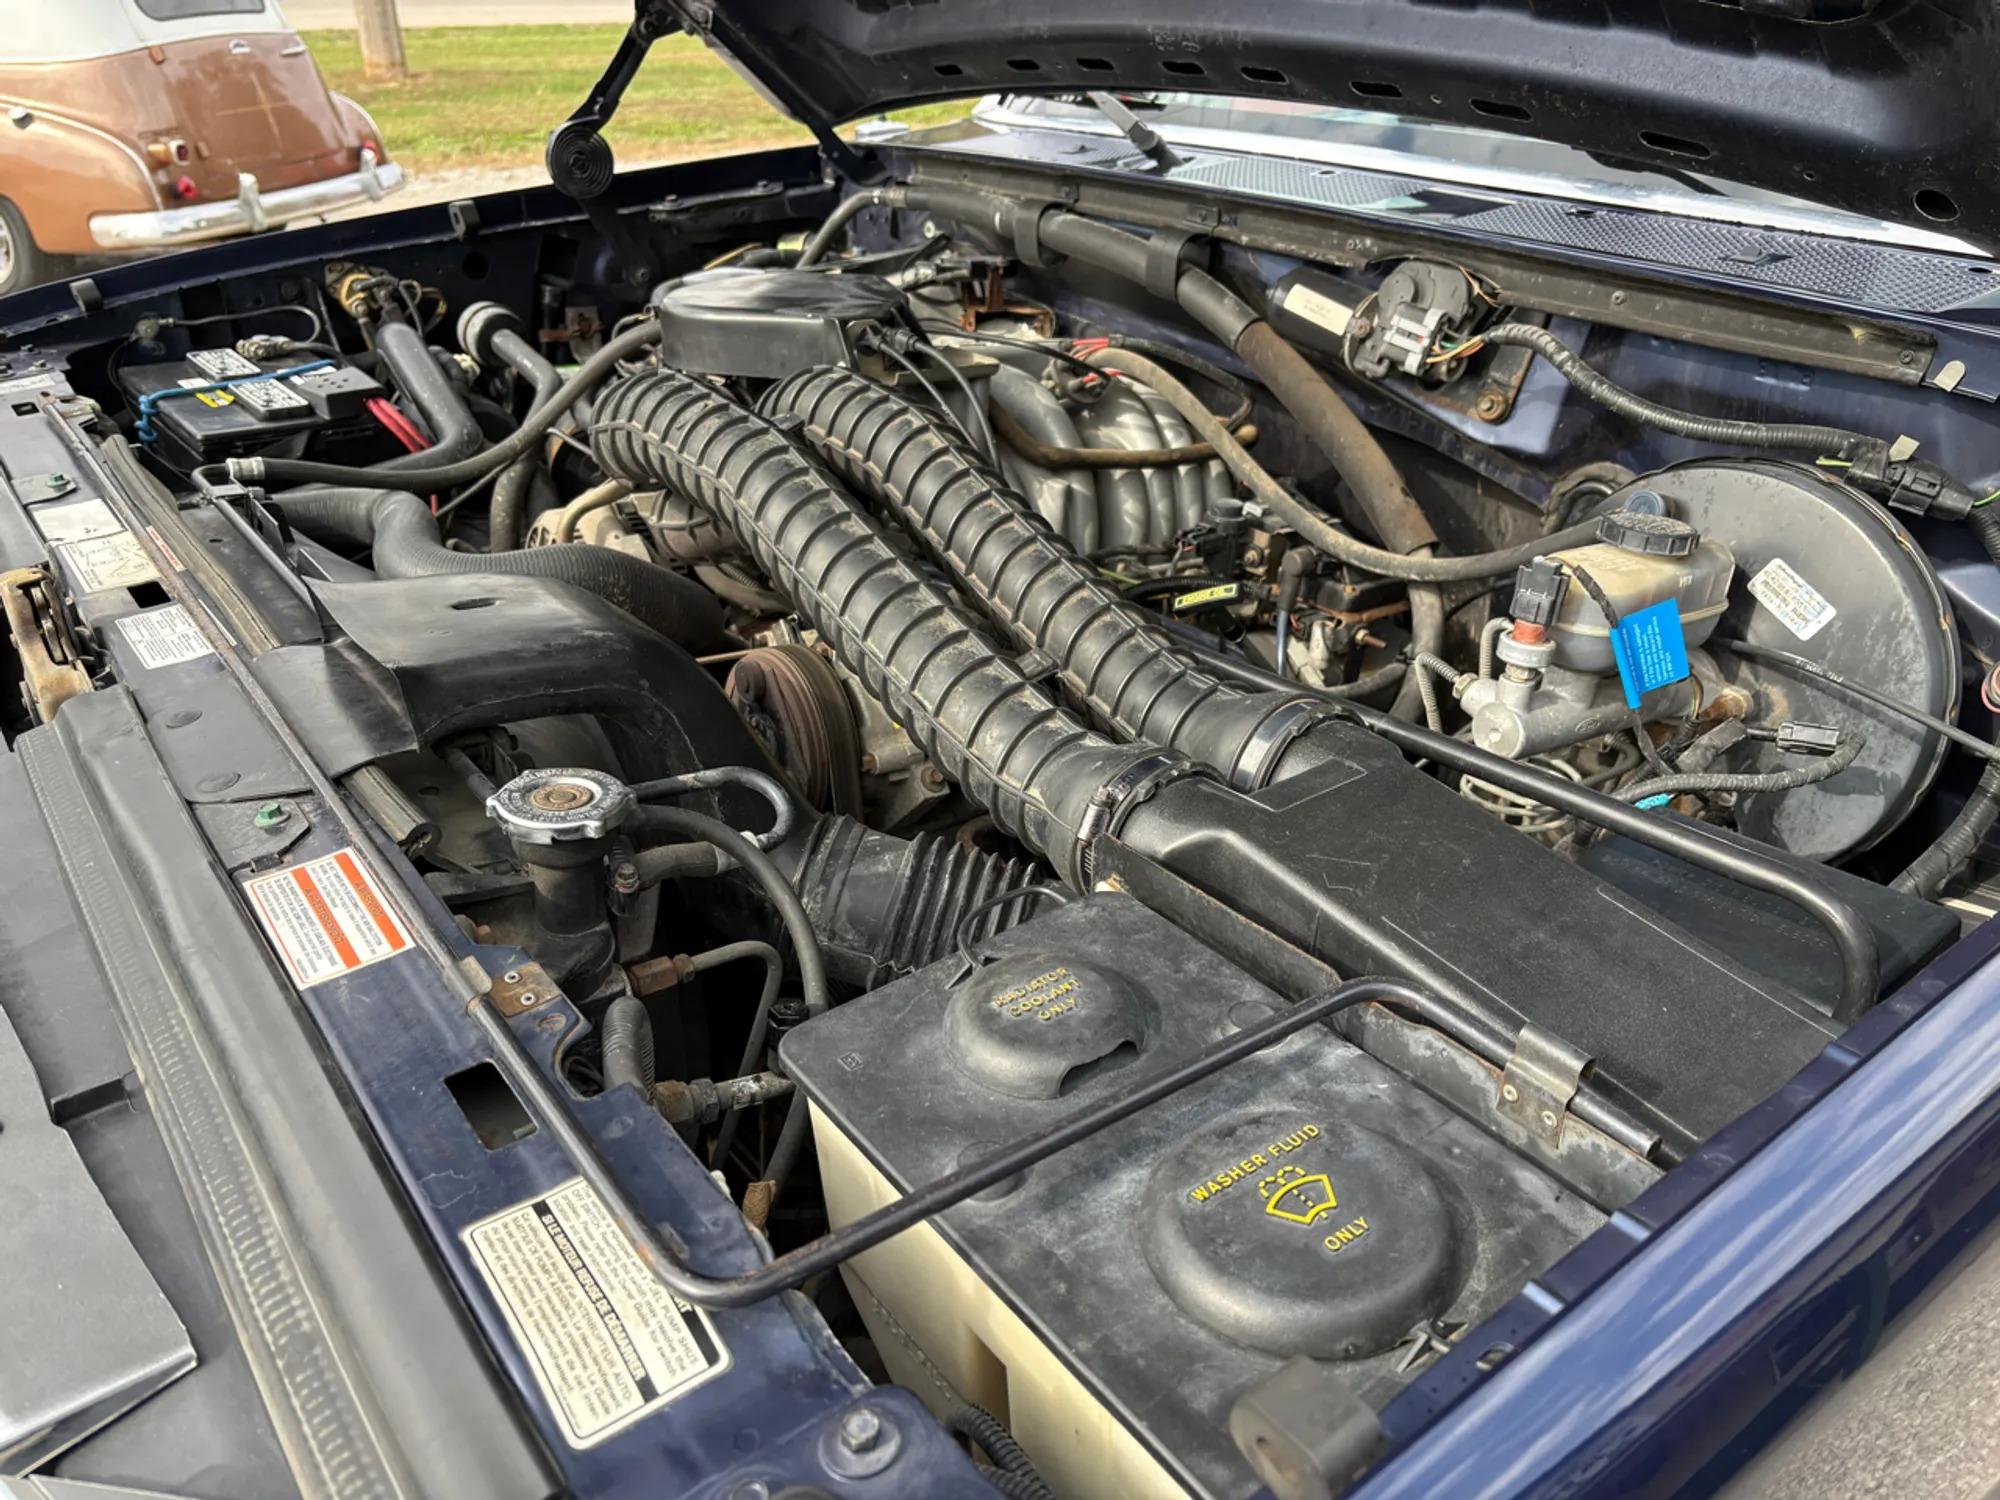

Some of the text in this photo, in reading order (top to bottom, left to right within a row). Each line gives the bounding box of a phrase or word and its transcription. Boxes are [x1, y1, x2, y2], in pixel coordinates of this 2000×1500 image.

[1009, 978, 1081, 1017] COOLANT
[1039, 996, 1076, 1021] ONLY
[1190, 1123, 1322, 1203] WASHER FLUID
[540, 1212, 555, 1225] SI
[547, 1222, 561, 1235] LE
[1323, 1215, 1371, 1252] ONLY
[552, 1231, 583, 1271] MOTEUR
[571, 1188, 585, 1202] OFF
[643, 1299, 658, 1318] may
[655, 1319, 678, 1353] resolve
[674, 1354, 688, 1371] the
[574, 1265, 604, 1302] REFUSE
[594, 1298, 612, 1315] DE
[610, 1265, 621, 1278] the
[632, 1301, 653, 1328] Guide
[648, 1329, 661, 1344] for
[656, 1345, 678, 1376] switch
[660, 1304, 682, 1335] PUMP
[573, 1299, 618, 1368] INTERRUPTEUR
[565, 1357, 577, 1371] de
[573, 1373, 587, 1390] cet
[585, 1372, 598, 1386] Le
[592, 1385, 615, 1415] Guide
